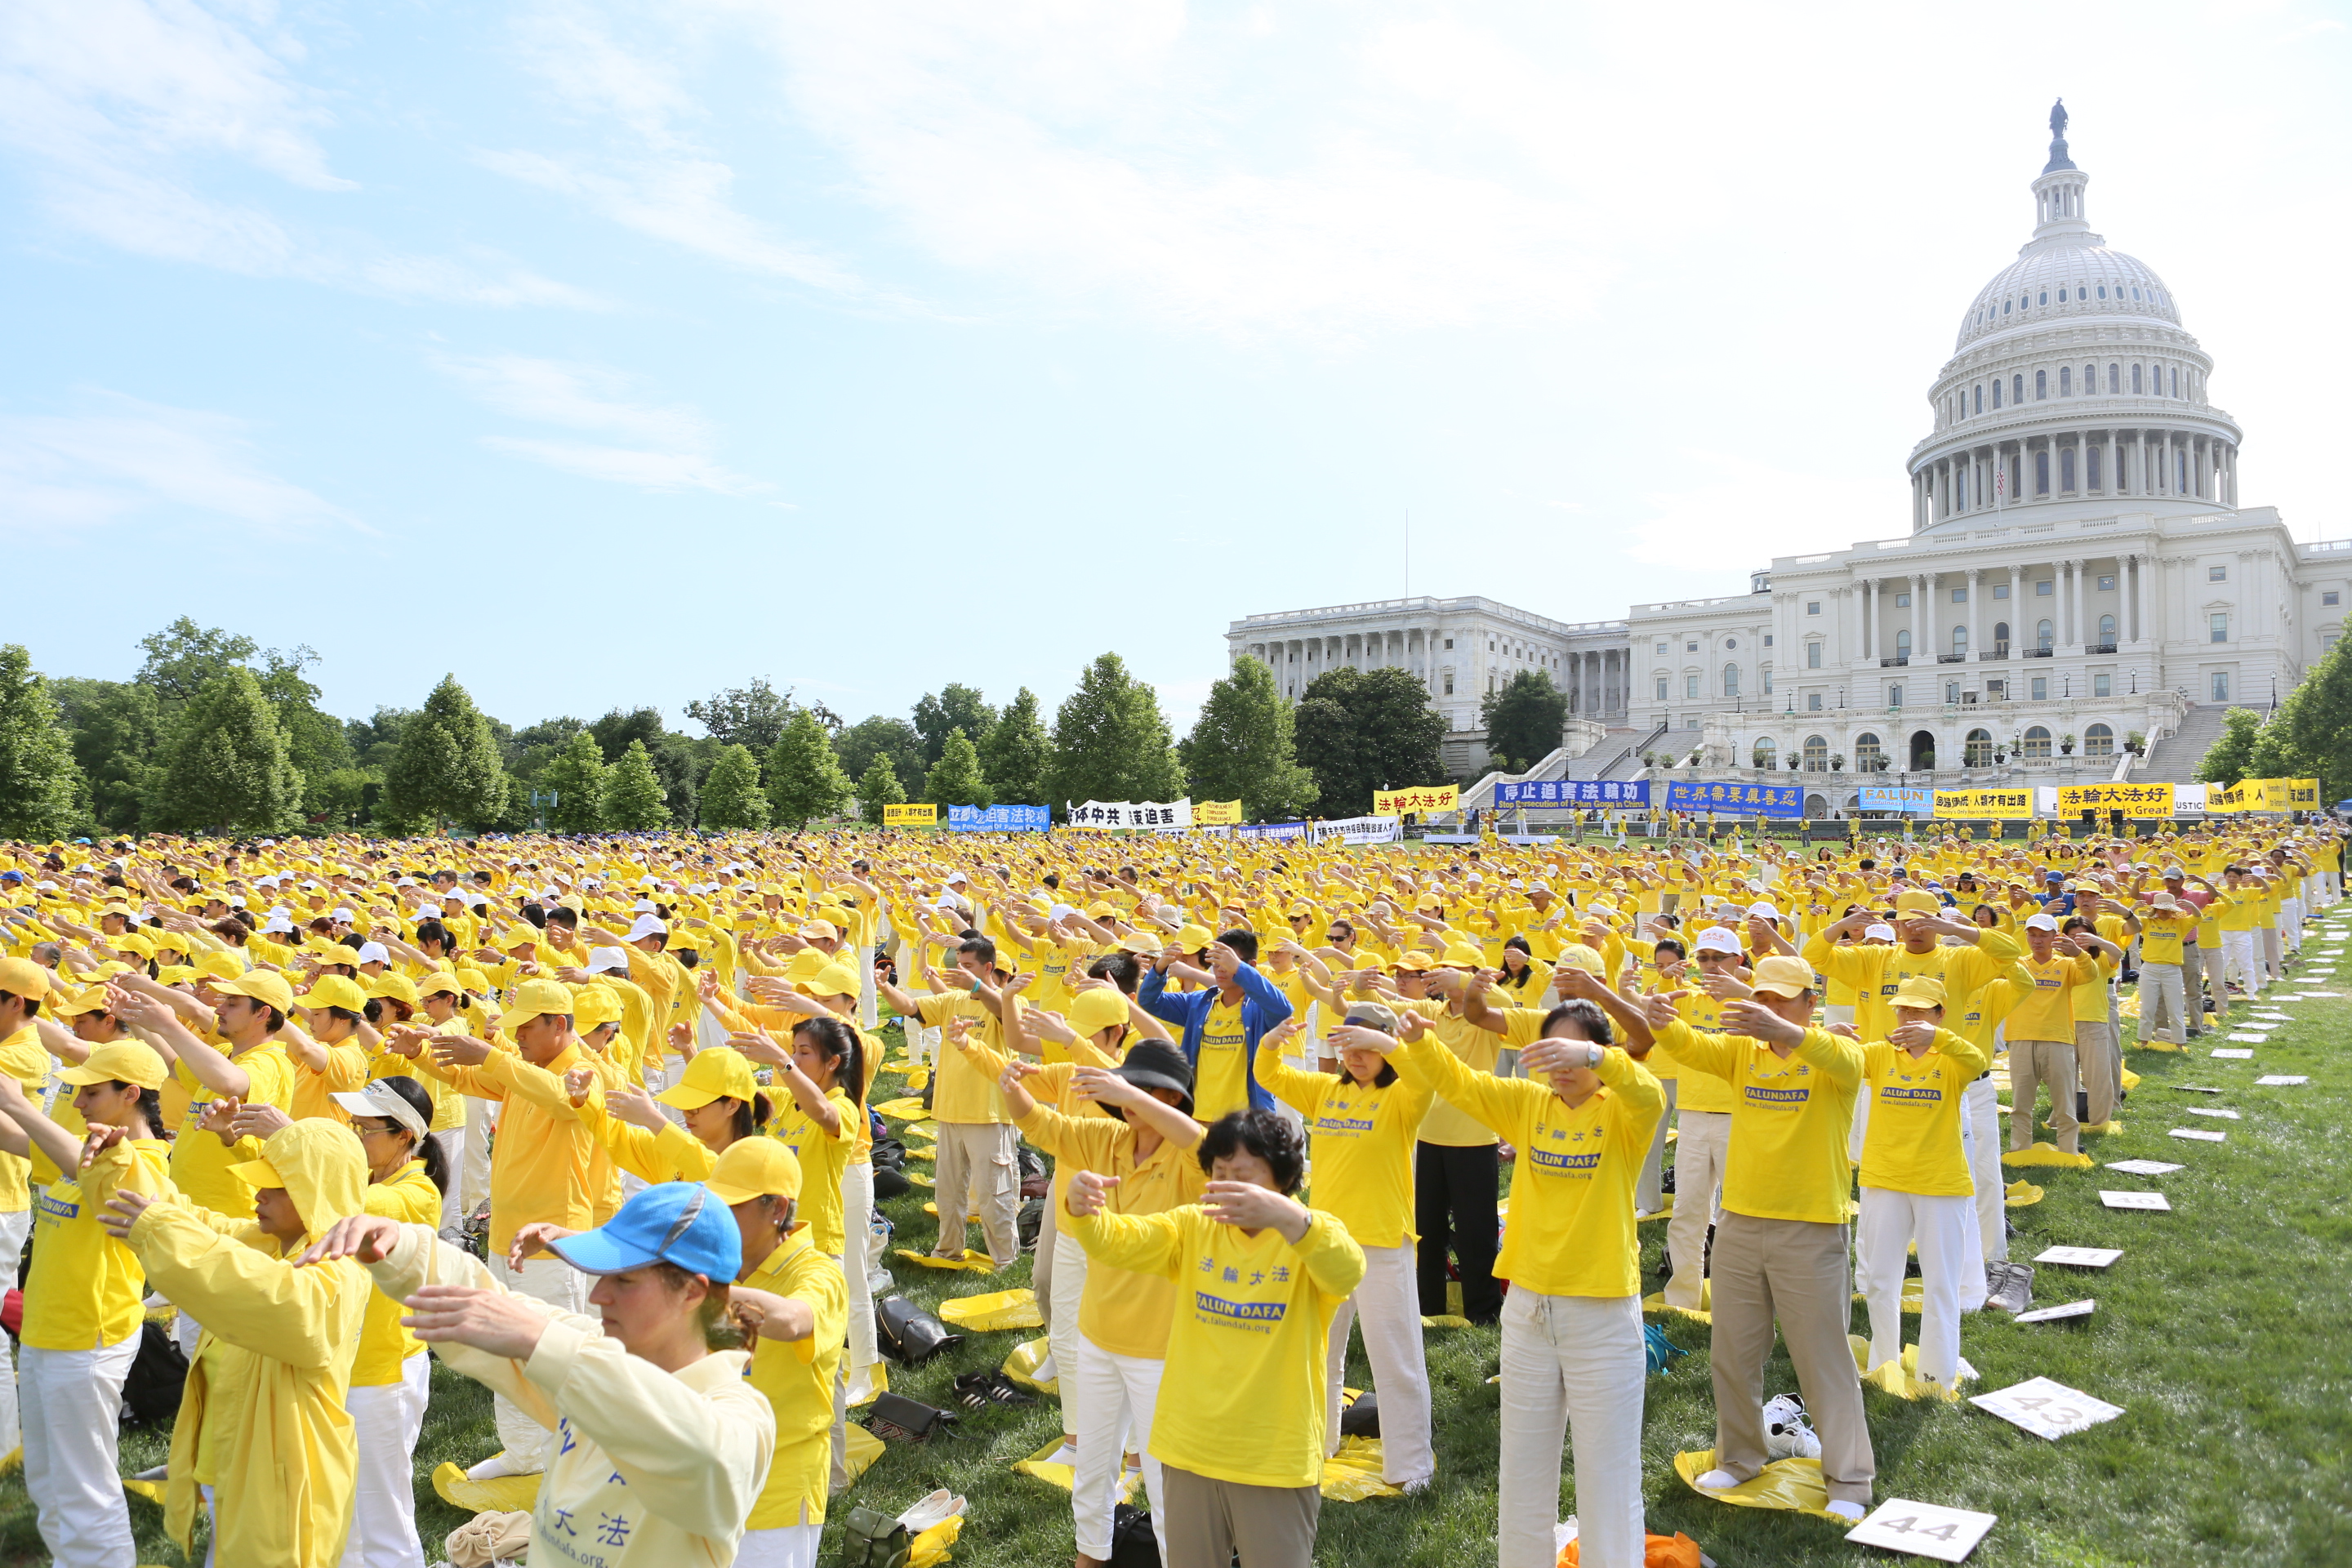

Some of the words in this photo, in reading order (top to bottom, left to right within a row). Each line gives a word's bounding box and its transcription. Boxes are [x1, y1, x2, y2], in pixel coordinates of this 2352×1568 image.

[1504, 782, 1638, 800] 停止迫害法輪功
[1865, 789, 1923, 801] FALUN
[2063, 788, 2168, 804] 法輪大法好
[1379, 792, 1452, 810] 法輪大法好
[1499, 800, 1514, 808] Stop
[1516, 800, 1559, 808] Persecution
[1570, 800, 1592, 808] Falun
[1594, 800, 1615, 808] Gong
[1624, 800, 1645, 808] China
[1713, 804, 1740, 812] Truthfulness
[2094, 806, 2114, 815] Daf
[2135, 805, 2167, 815] Great
[1883, 987, 1898, 995] FAL
[1882, 1088, 1910, 1097] FALUN
[1913, 1090, 1940, 1099] DAFA
[1881, 1099, 1932, 1108] www.falundafa.org
[1343, 1120, 1370, 1129] DAFA
[1531, 1149, 1563, 1166] FALUN
[1566, 1156, 1598, 1167] DAFA
[2112, 1197, 2156, 1205] 40
[52, 1202, 74, 1216] DAFA
[1198, 1256, 1290, 1285] 法輪大法
[1197, 1294, 1236, 1316] FALUN
[1241, 1305, 1283, 1318] DAFA
[2010, 1396, 2083, 1425] 43
[1878, 1516, 1961, 1542] 44
